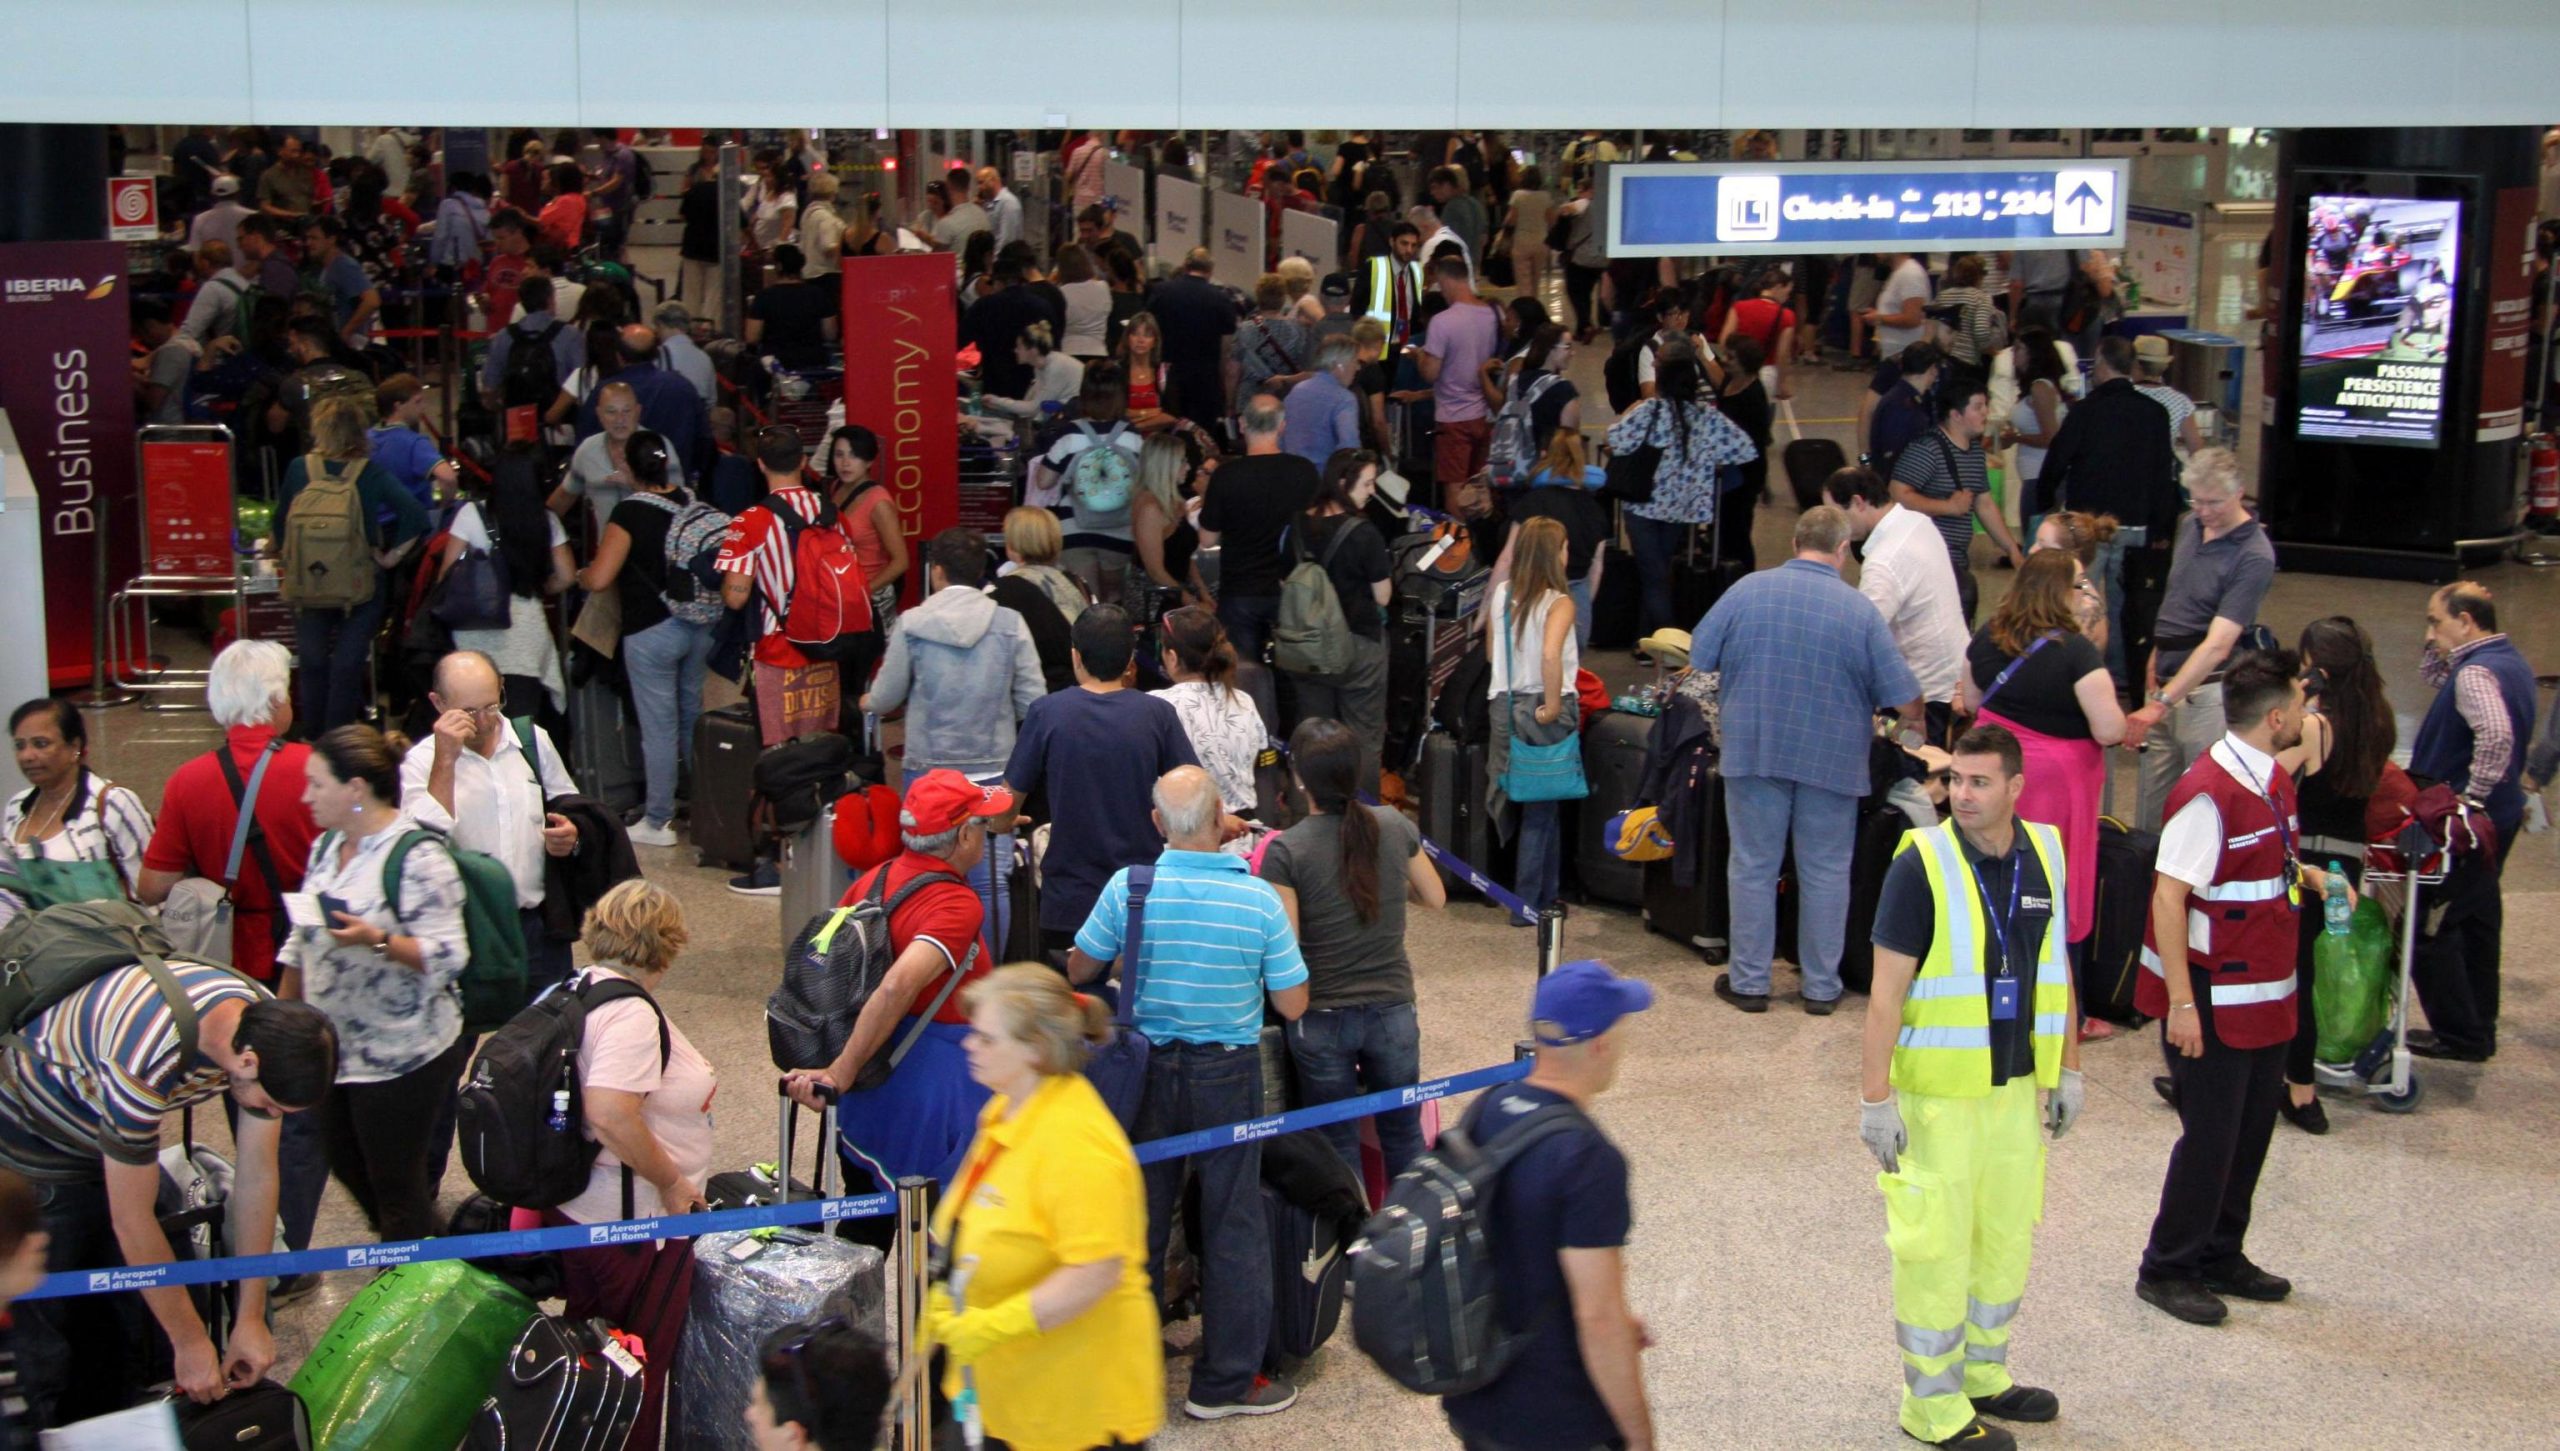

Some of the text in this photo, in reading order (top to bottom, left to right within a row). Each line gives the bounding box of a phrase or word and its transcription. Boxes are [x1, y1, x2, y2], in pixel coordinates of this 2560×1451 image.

[1932, 191, 1981, 217] 213
[2000, 190, 2054, 215] 236
[5, 278, 86, 294] IBERIA
[2377, 364, 2442, 380] PASSION
[2343, 377, 2441, 396] PERSISTENCE
[2335, 392, 2440, 410] ANTICIPATION
[48, 348, 95, 535] Business
[1248, 1116, 1285, 1131] Aeroporti
[1248, 1127, 1278, 1139] di Roma
[841, 1196, 887, 1209] Aeroporti
[841, 1206, 879, 1217] di Roma
[610, 1221, 659, 1234] Aeroporti
[610, 1232, 650, 1242] di Roma
[368, 1243, 420, 1256] Aeroporti
[368, 1254, 410, 1265] di Roma
[111, 1267, 166, 1281] Aeroporti
[111, 1279, 157, 1290] di Roma
